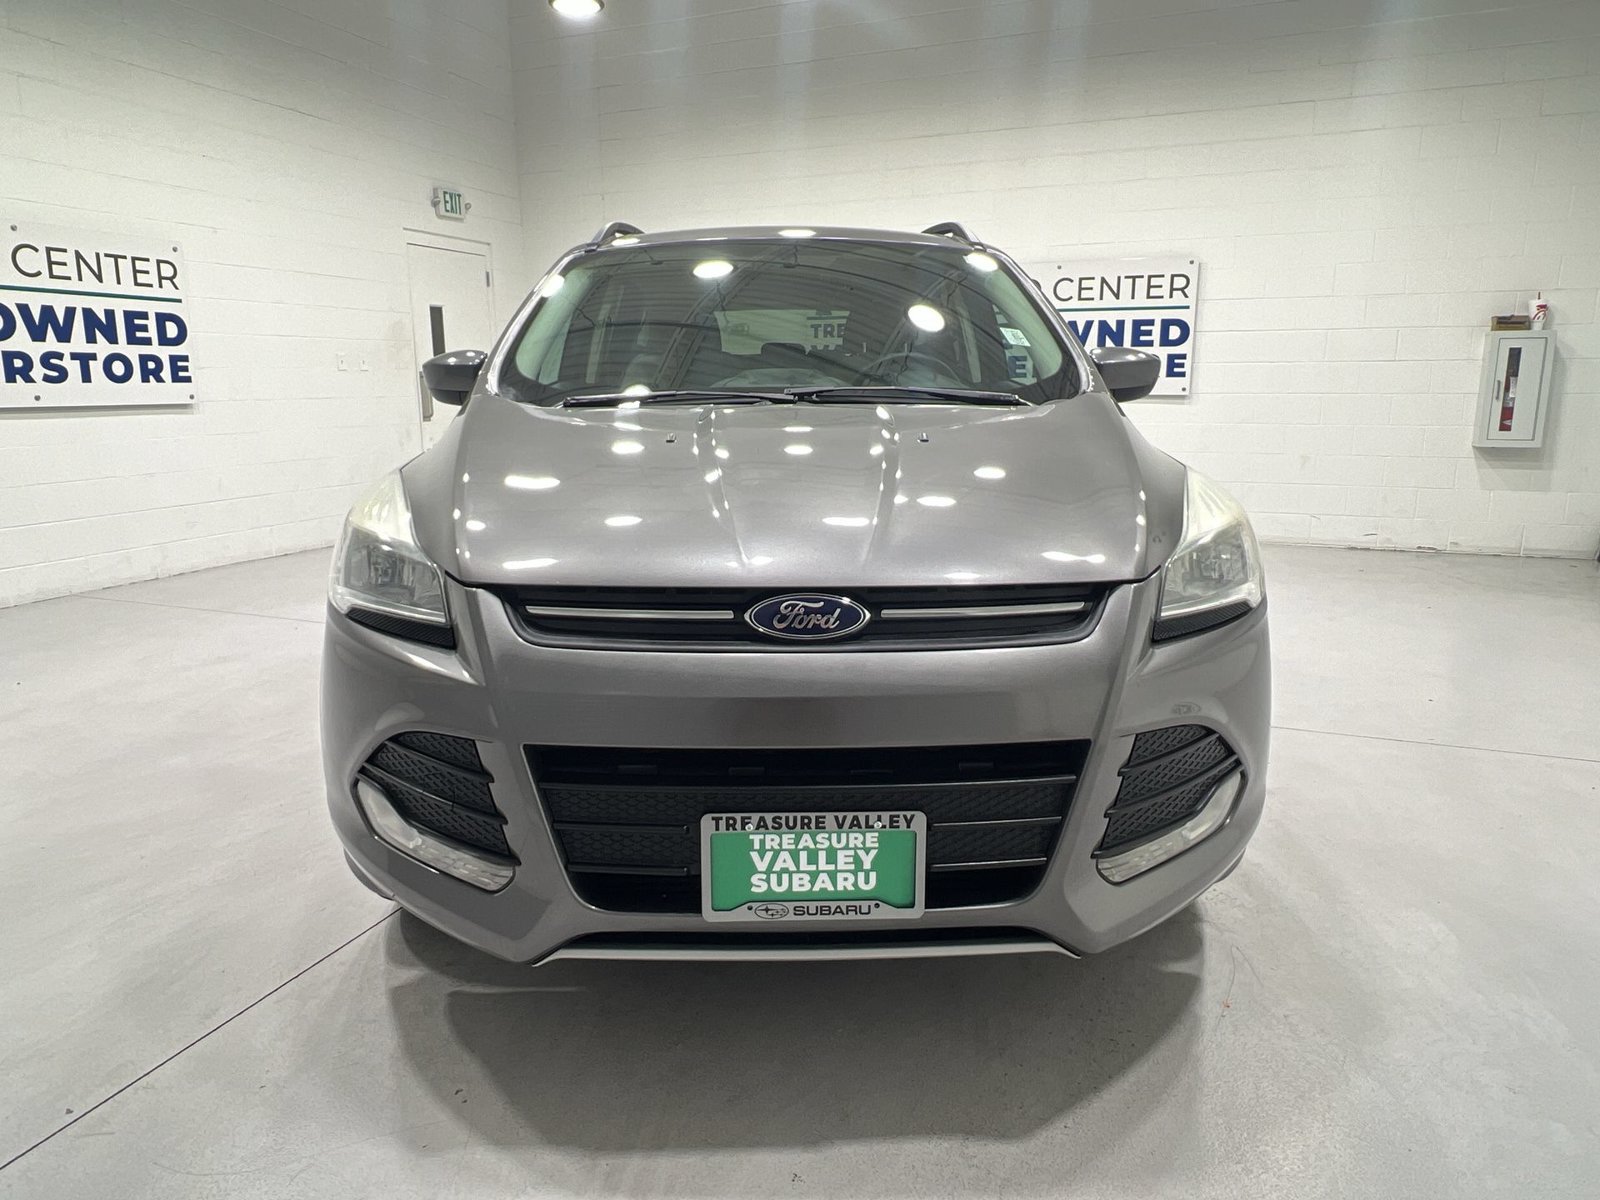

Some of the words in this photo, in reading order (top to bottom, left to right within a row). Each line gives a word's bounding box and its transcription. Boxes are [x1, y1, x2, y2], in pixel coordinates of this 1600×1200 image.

[442, 190, 462, 215] EXIT
[11, 243, 180, 290] CENTER
[1052, 273, 1191, 302] CENTER
[2, 350, 193, 384] RSTORE
[772, 600, 842, 629] Ford
[711, 815, 827, 832] TREASURE
[834, 814, 916, 831] VALLEY
[749, 832, 880, 850] TREASURE
[750, 849, 879, 872] VALLEY
[750, 871, 877, 893] SUBARU
[793, 904, 872, 916] SUBARU
